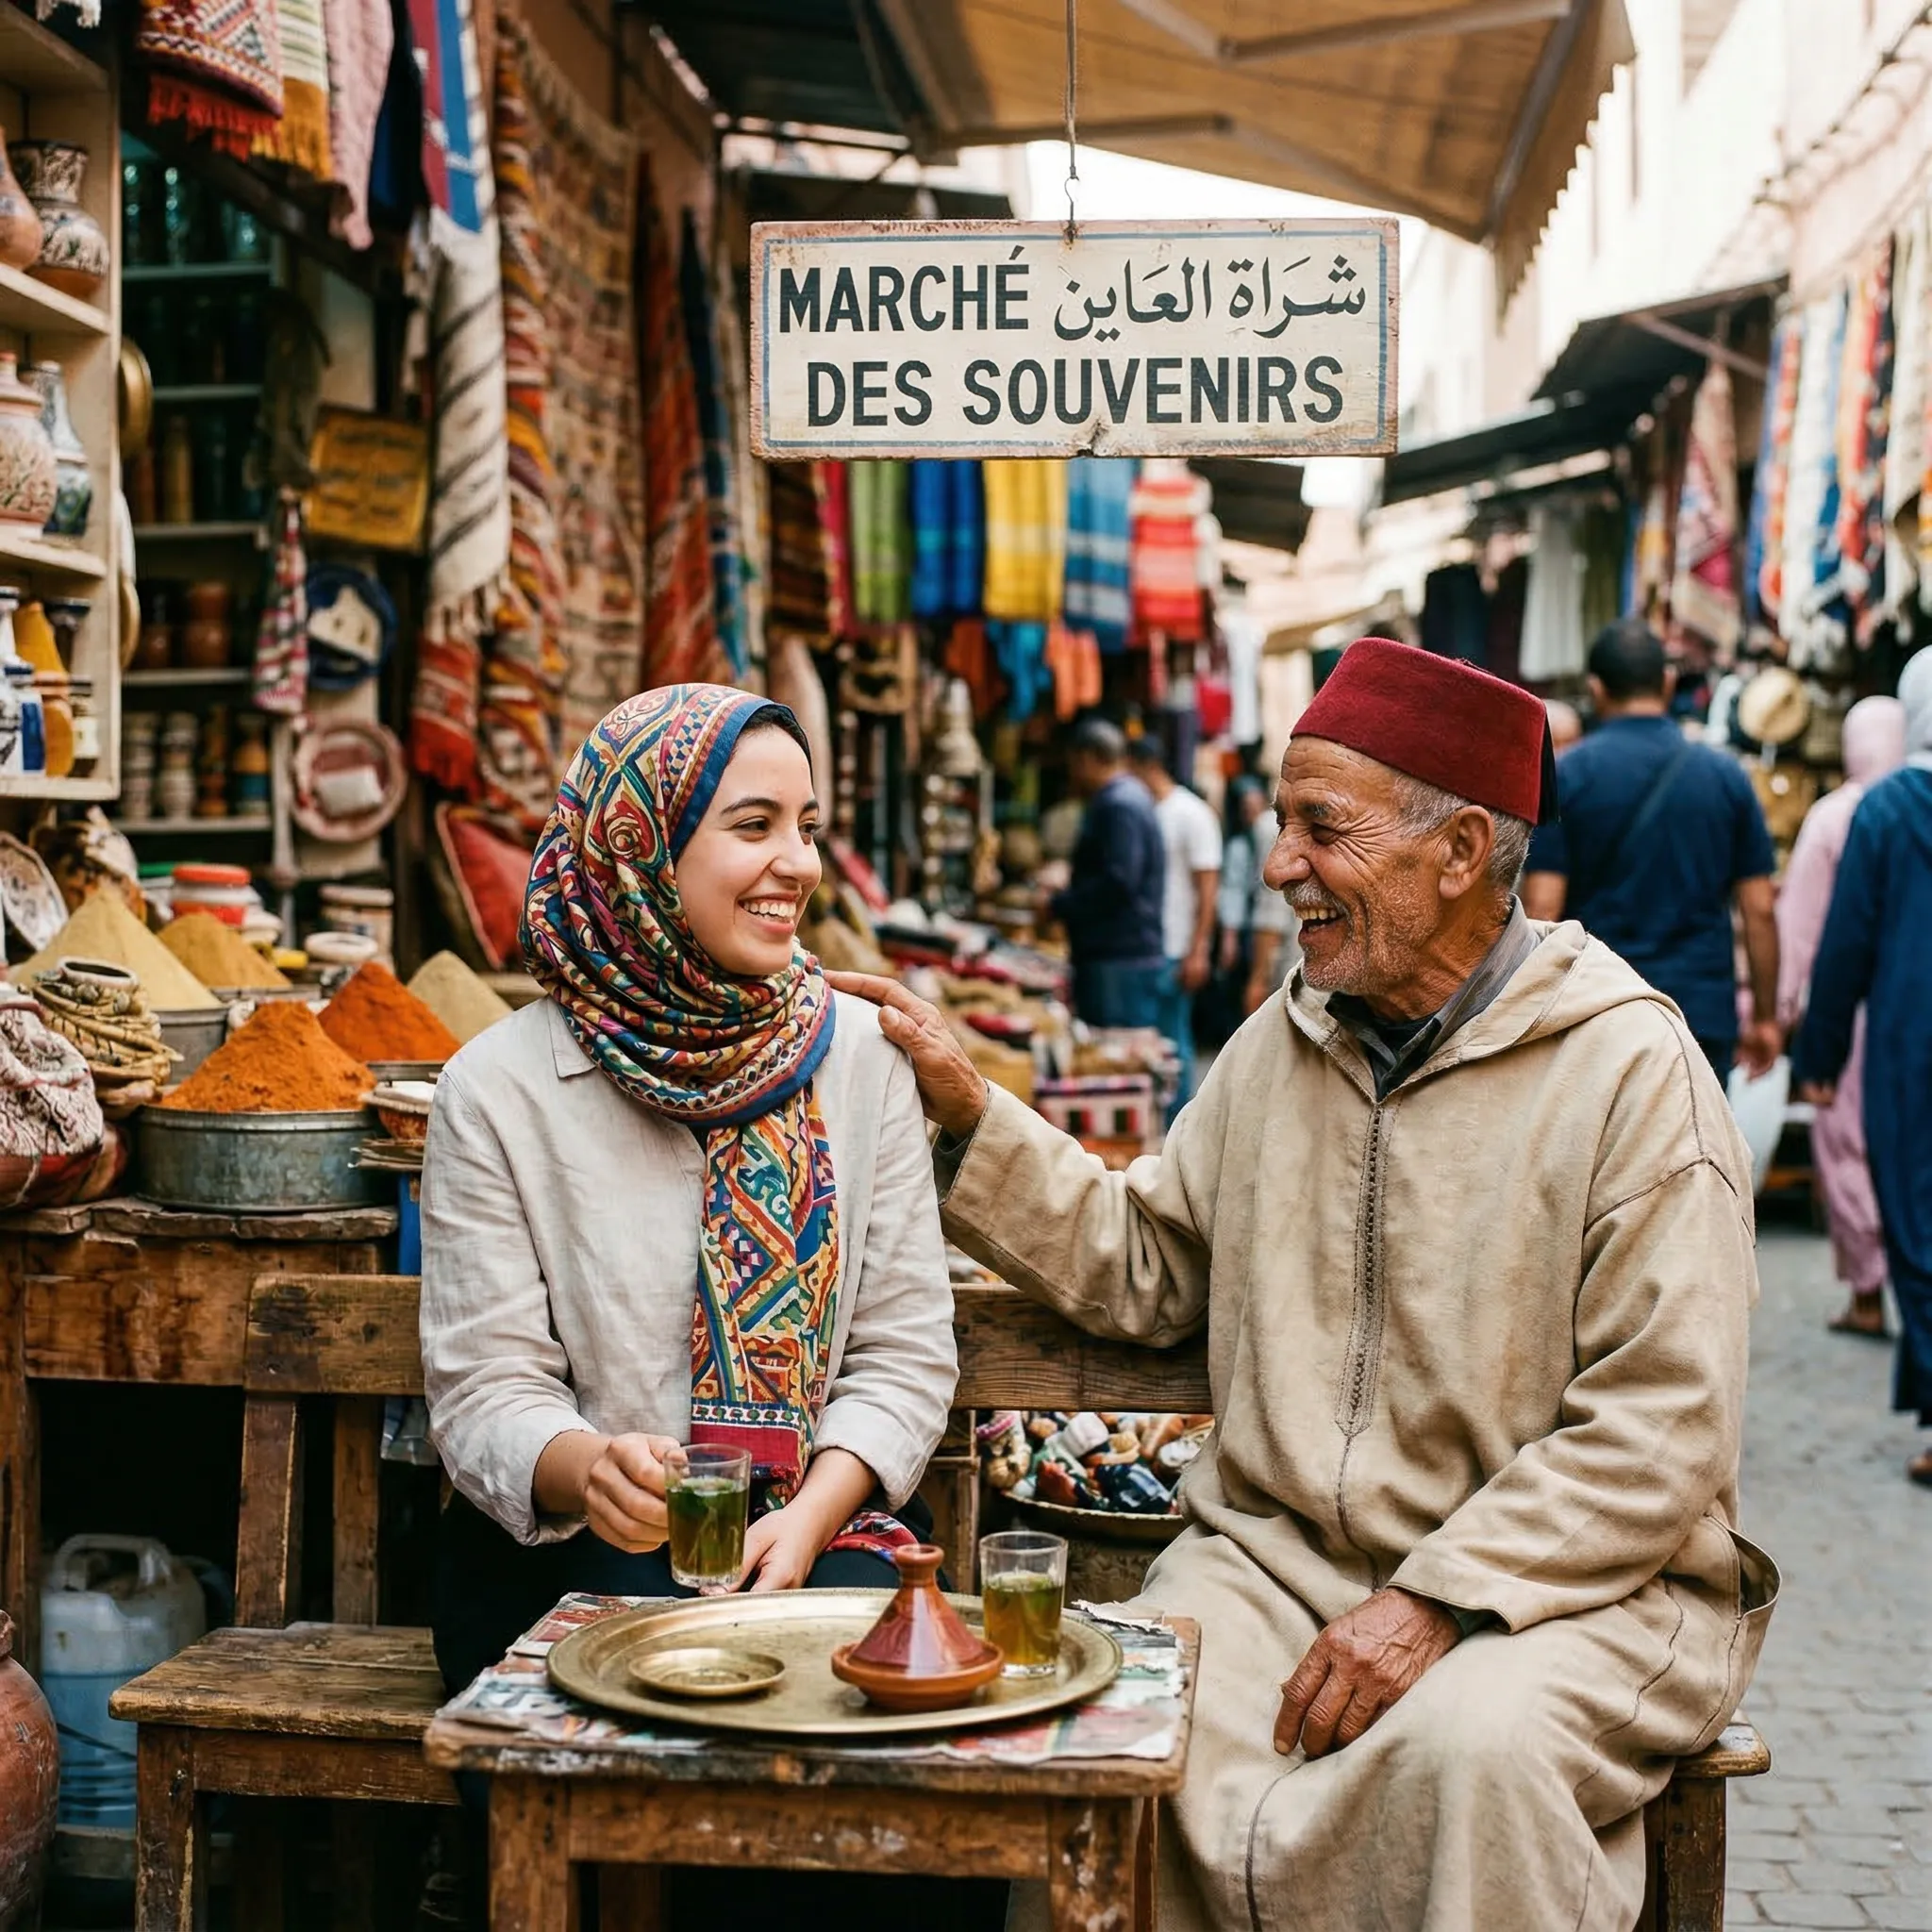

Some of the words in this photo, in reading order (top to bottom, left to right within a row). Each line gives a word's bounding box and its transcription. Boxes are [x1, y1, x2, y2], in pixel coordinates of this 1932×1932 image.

[778, 244, 1031, 334] MARCHÉ
[807, 360, 933, 427] DES
[961, 355, 1344, 425] SOUVENIRS
